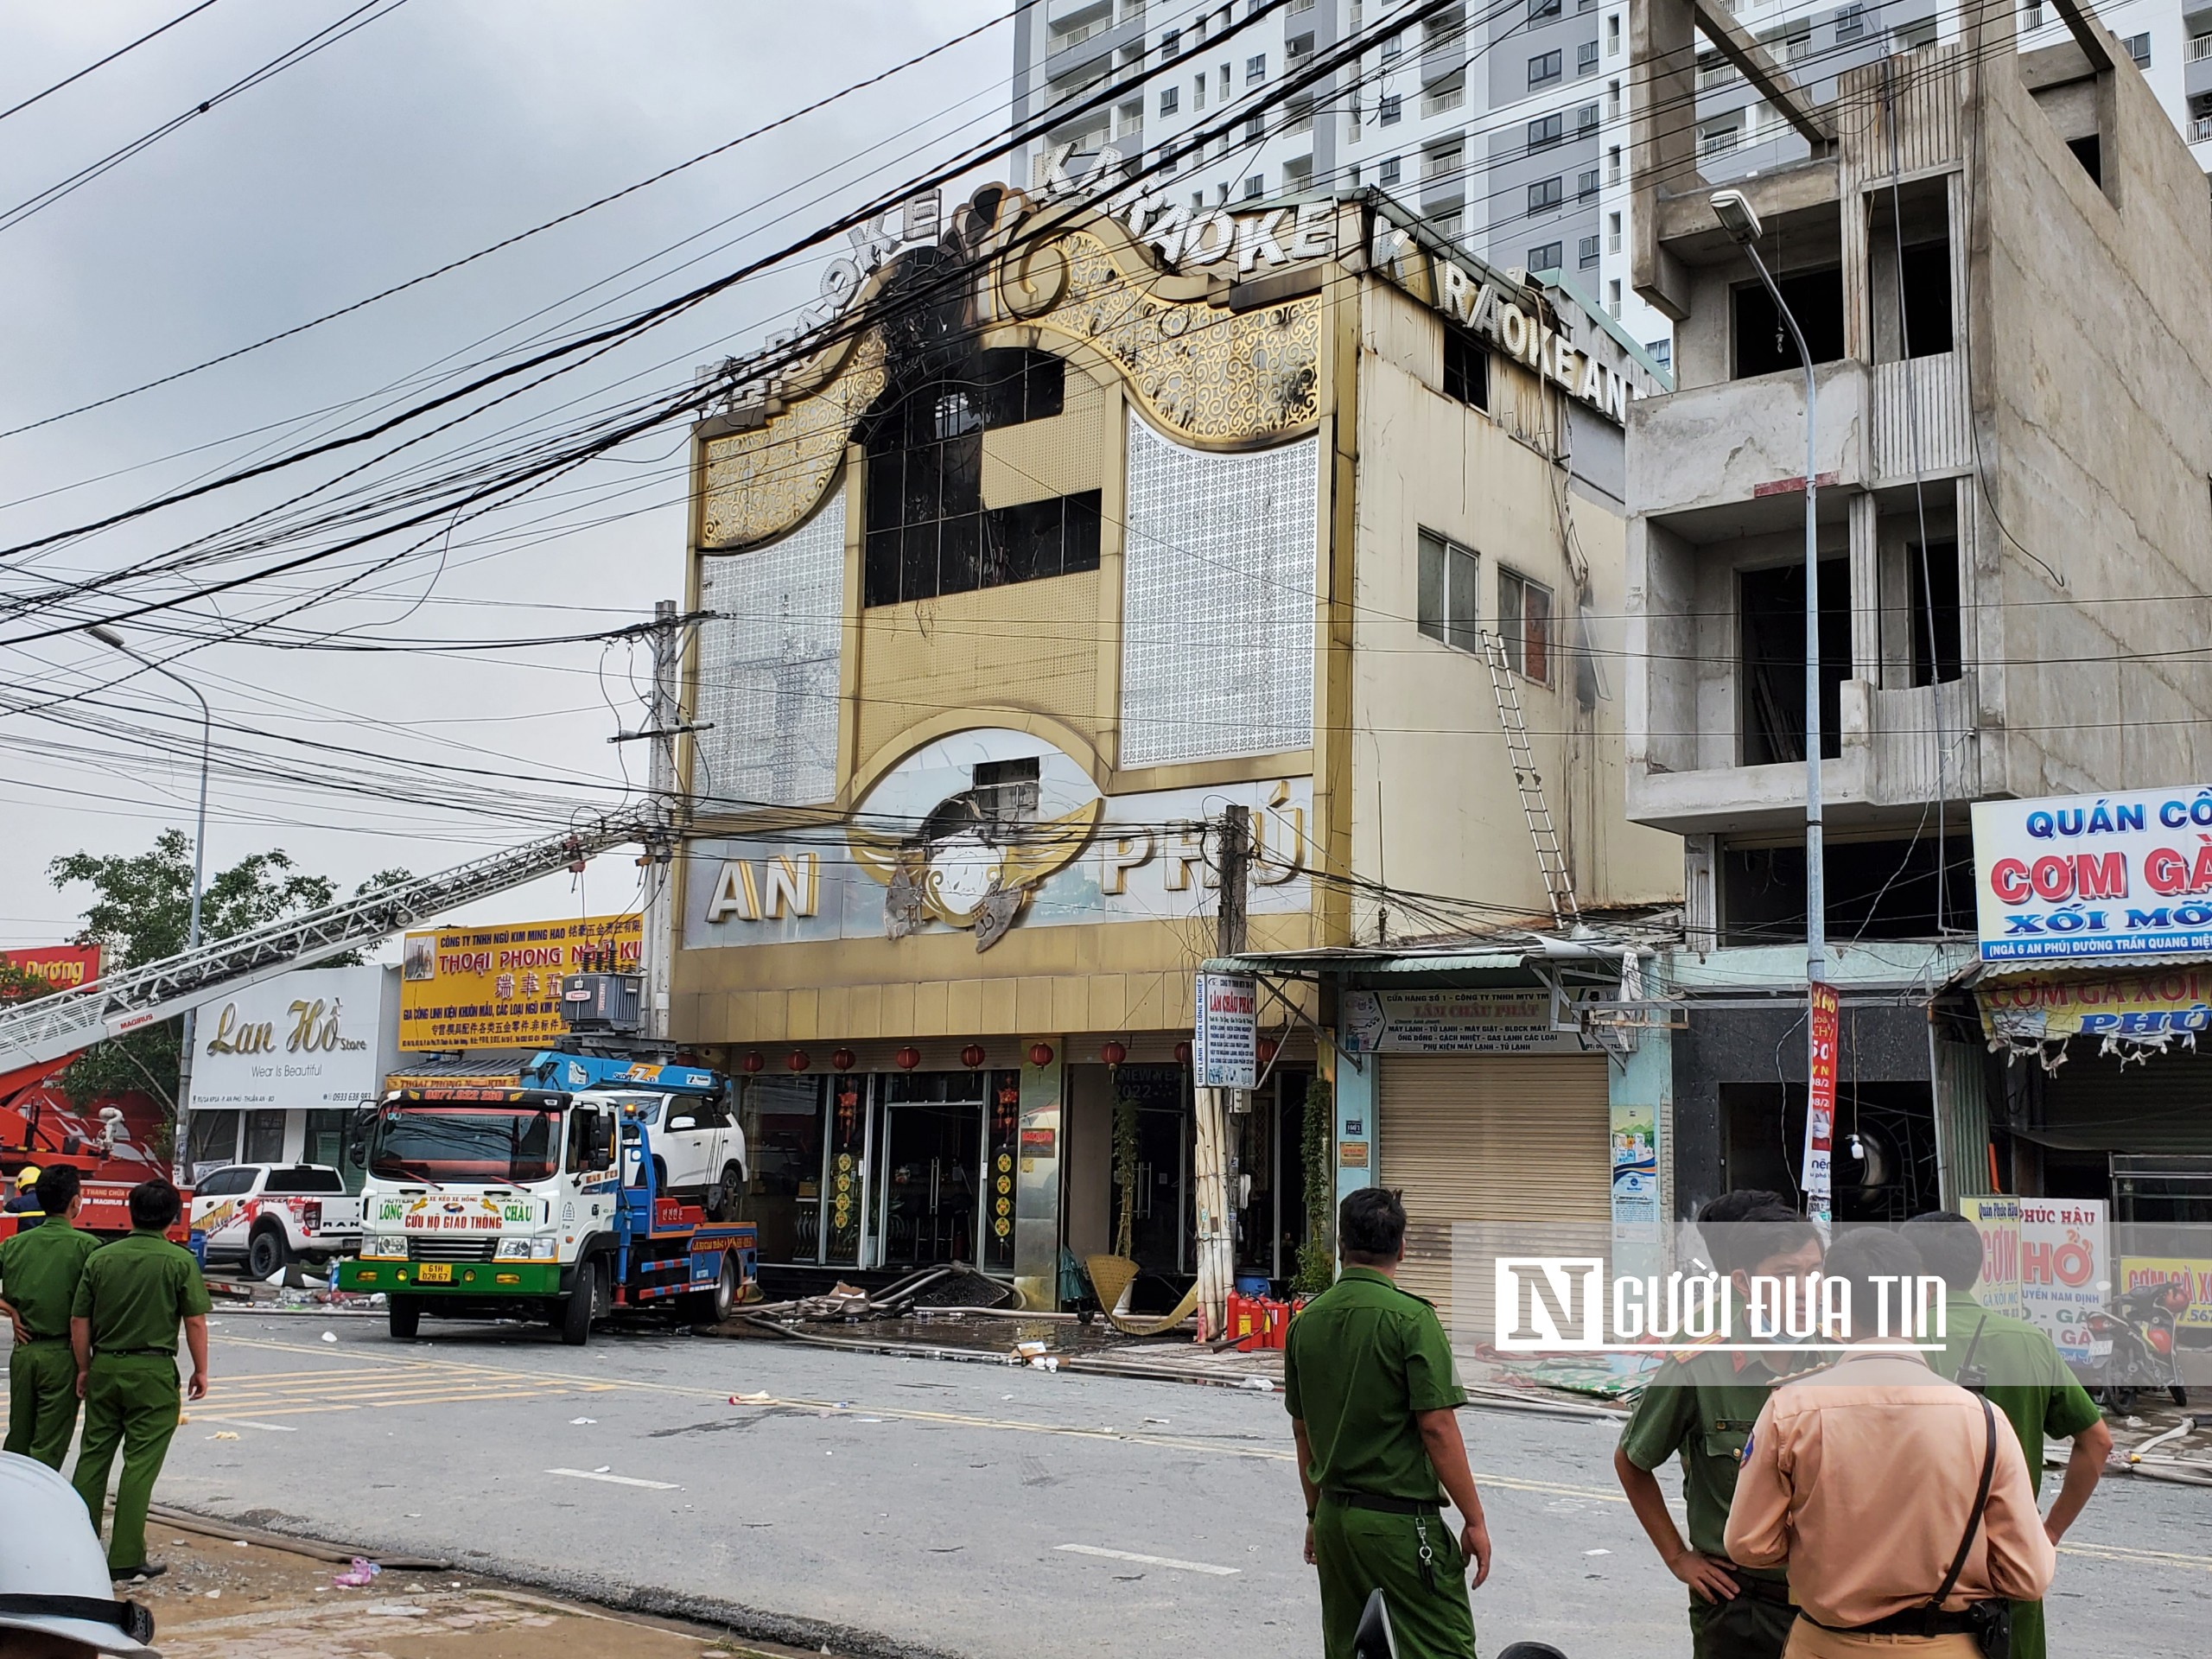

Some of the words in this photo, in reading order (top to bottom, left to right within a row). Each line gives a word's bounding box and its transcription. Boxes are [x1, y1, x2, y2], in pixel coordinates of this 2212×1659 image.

[1033, 141, 1338, 274] KARAOKE
[1371, 215, 1575, 398] KRAOKE
[2026, 798, 2144, 839] QUÁN
[706, 851, 819, 923] AN
[1102, 780, 1304, 895] PHÚ
[1991, 852, 2128, 905] CƠM
[2144, 834, 2212, 896] GÀ
[569, 919, 643, 938] 铭豪五金责任有限
[2004, 904, 2108, 936] XỐI
[441, 934, 461, 948] CÔNG
[462, 935, 471, 946] TY
[472, 934, 492, 945] TNHH
[511, 931, 525, 942] KIM
[527, 929, 548, 941] MING
[550, 927, 566, 939] HAO
[1989, 941, 2016, 957] (NGÃ
[2018, 944, 2024, 954] 6
[2027, 944, 2043, 954] AN
[2044, 938, 2070, 955] PHÚ)
[2072, 938, 2113, 951] ĐƯỜNG
[2115, 935, 2145, 950] TRẦN
[2148, 937, 2189, 949] QUANG
[2191, 934, 2212, 948] DIỆ
[439, 952, 493, 976] THOẠI
[499, 947, 563, 969] PHONG
[620, 941, 642, 961] KI
[1211, 989, 1222, 1012] LÂM
[1223, 991, 1238, 1014] CHÂU
[1239, 991, 1254, 1014] PHÁT
[1405, 993, 1427, 1001] HÀNG
[1455, 993, 1477, 1001] CÔNG
[1990, 977, 2070, 1008] CƠM
[120, 1014, 154, 1029] MAGIRUS
[404, 1008, 412, 1020] GIA
[414, 1007, 429, 1020] CÔNG
[430, 1007, 442, 1019] LINH
[496, 1001, 508, 1016] CÁC
[510, 1003, 524, 1017] LOẠI
[540, 1001, 552, 1014] KIM
[2080, 1003, 2212, 1034] PHÚ
[207, 1002, 277, 1058] Lan
[286, 996, 343, 1053] Hồ
[340, 1038, 367, 1051] Store
[251, 1065, 273, 1077] Wear
[276, 1065, 282, 1077] Is
[284, 1064, 322, 1077] Beautiful
[378, 1204, 403, 1220] LONG
[443, 1217, 467, 1229] GIAO
[471, 1213, 503, 1230] THÔNG
[504, 1201, 533, 1222] CHÂU
[1981, 1225, 2018, 1286] CƠM
[2050, 1292, 2072, 1302] NAM
[2075, 1294, 2100, 1306] ĐỊNH
[2061, 1326, 2092, 1345] GÀ
